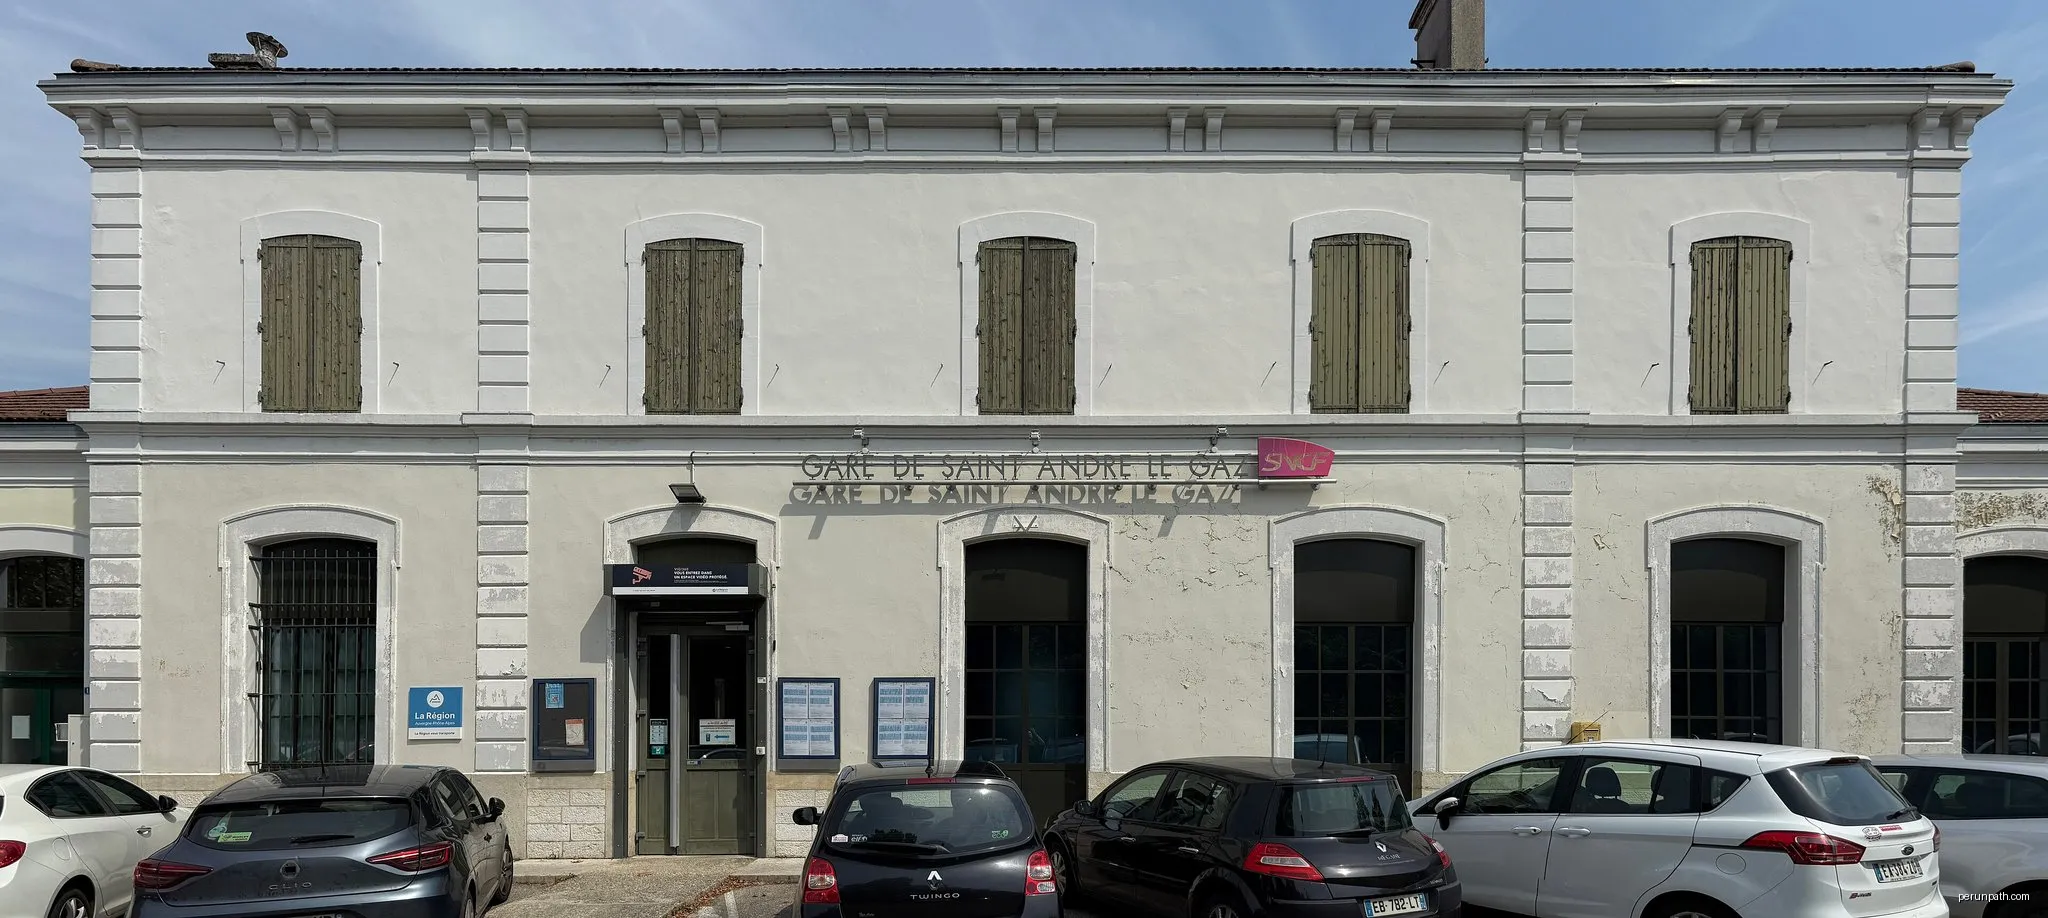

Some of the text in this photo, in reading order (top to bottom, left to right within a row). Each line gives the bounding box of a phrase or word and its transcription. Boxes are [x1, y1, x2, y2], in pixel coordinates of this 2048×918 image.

[802, 454, 1251, 479] GARE DE SAINT ANDRE LE GAZ
[1261, 451, 1331, 472] SNCF
[426, 712, 455, 720] Région
[268, 882, 312, 890] CLIO
